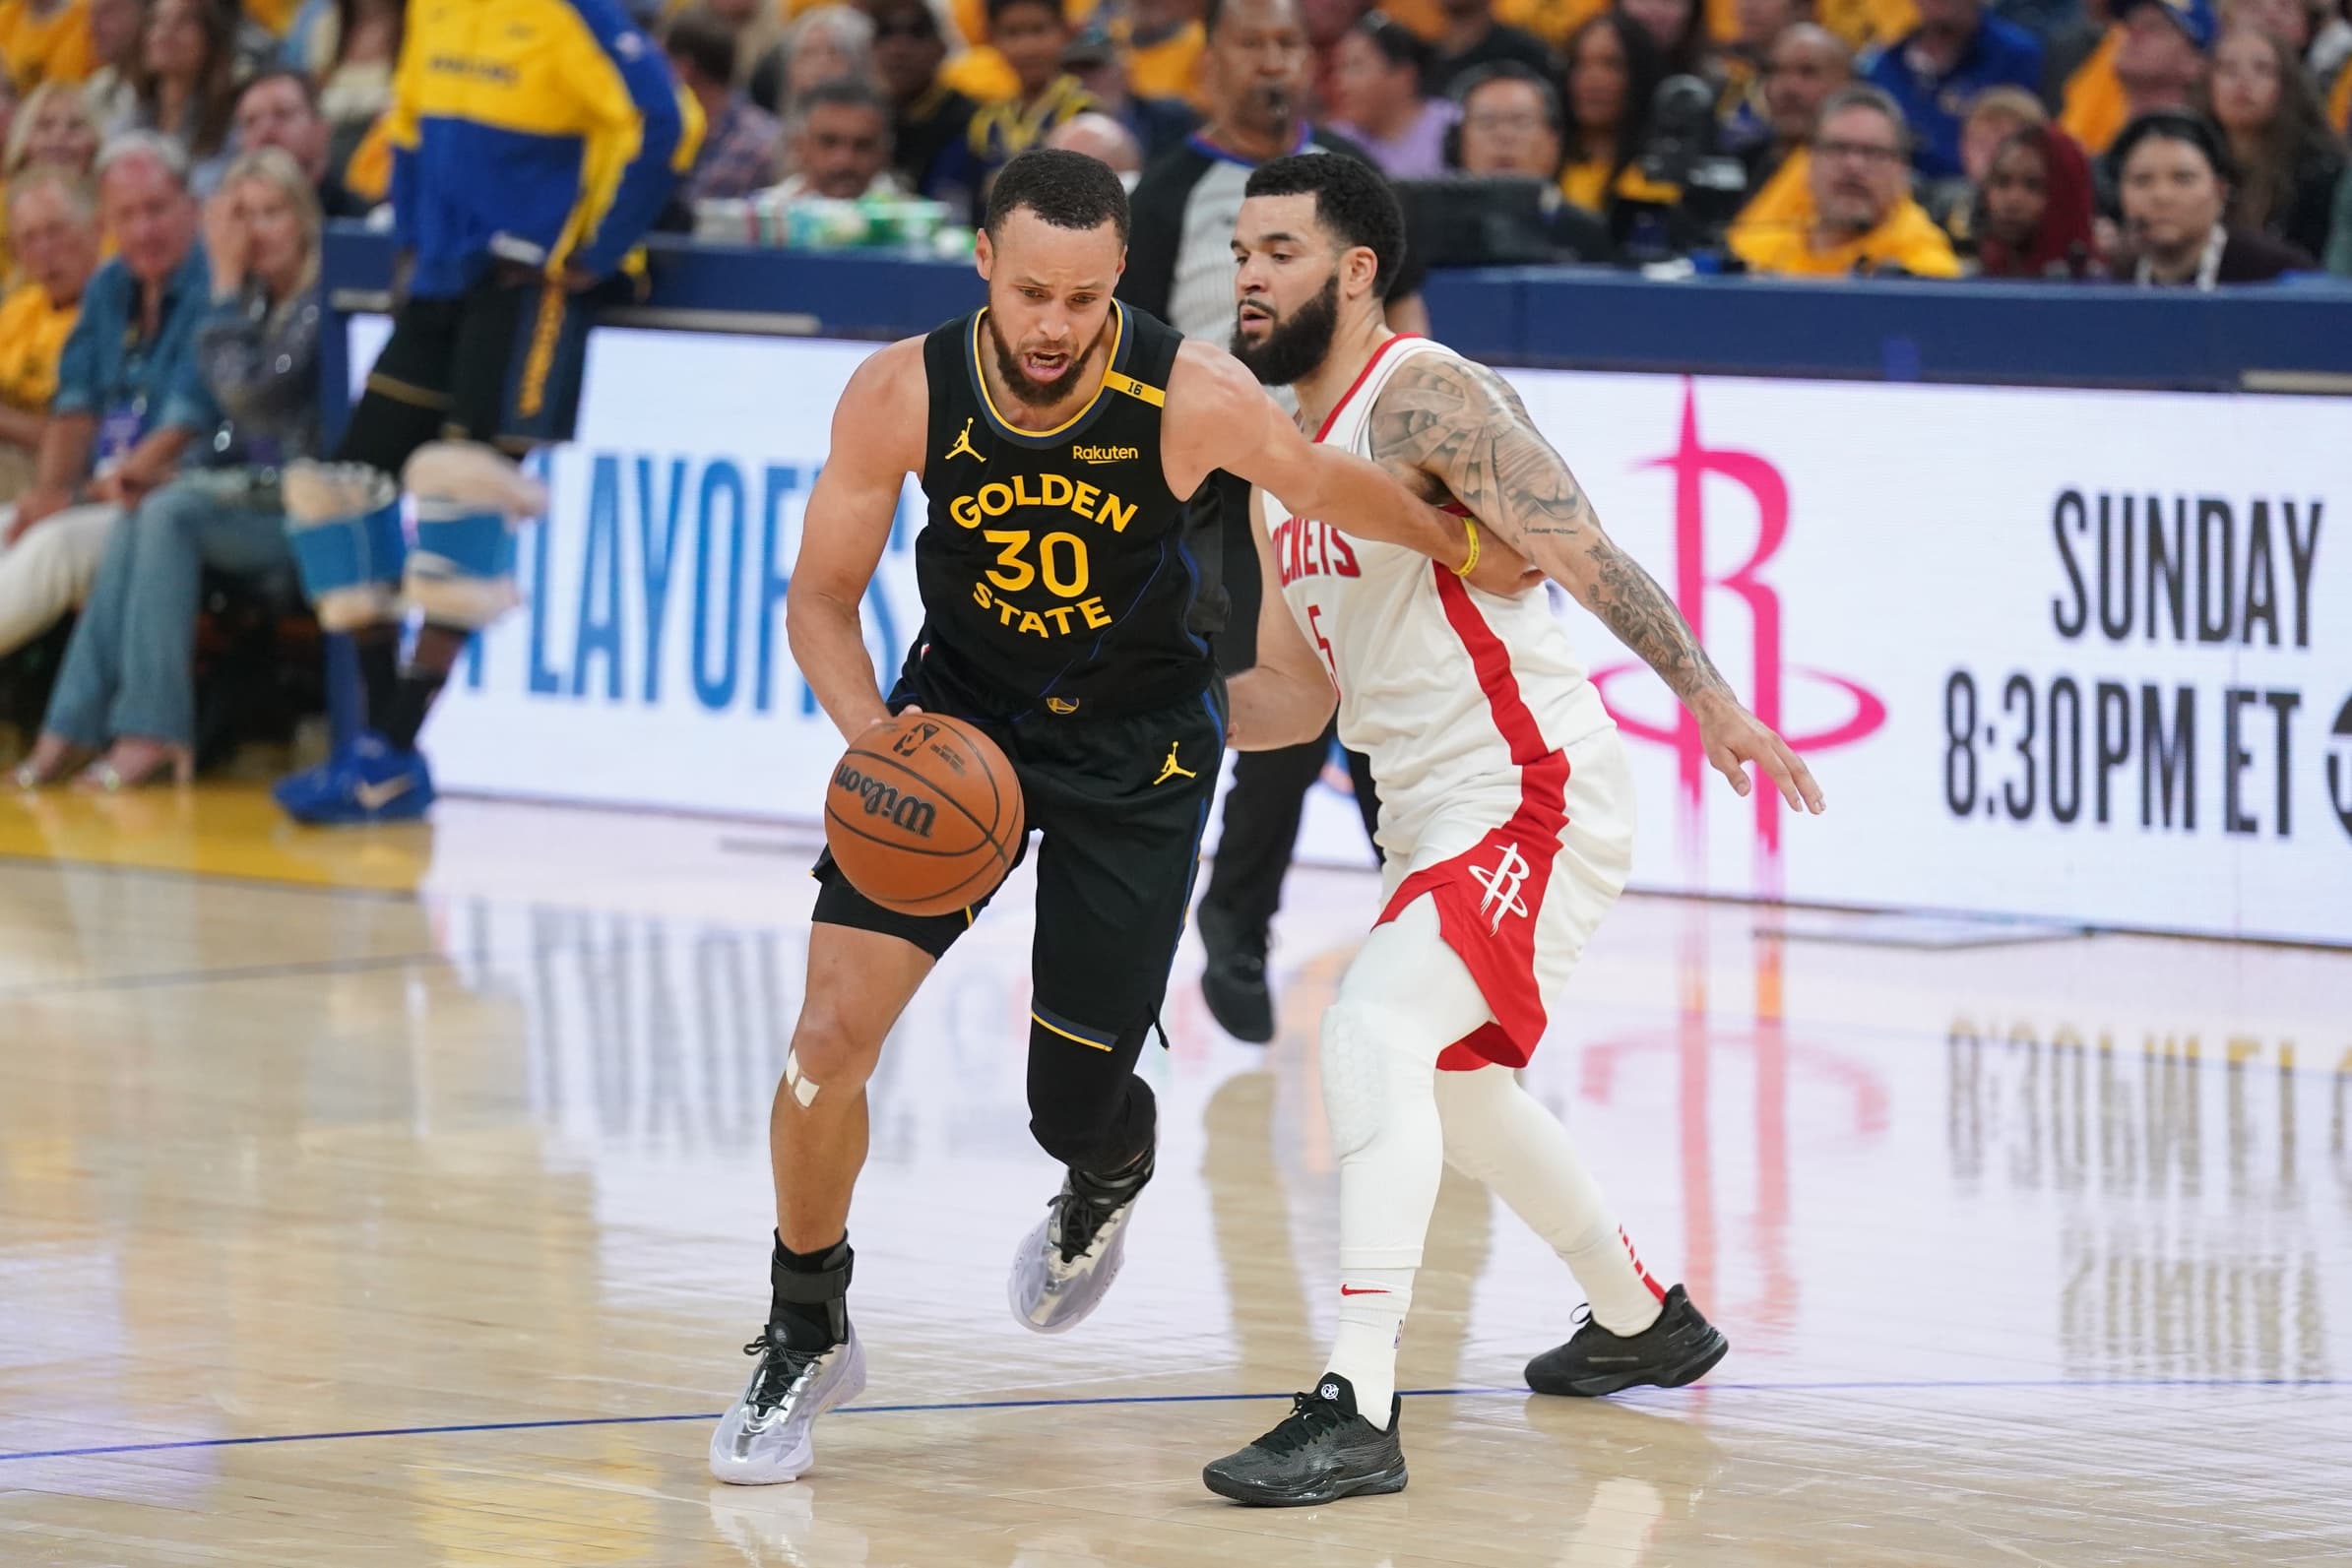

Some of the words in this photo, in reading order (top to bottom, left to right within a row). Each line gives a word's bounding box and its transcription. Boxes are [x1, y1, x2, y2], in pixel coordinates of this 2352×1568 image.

[1127, 381, 1143, 396] 16
[1072, 445, 1138, 463] Rakuten
[950, 473, 1138, 533] GOLDEN
[983, 530, 1089, 597] 30
[2051, 489, 2323, 648] SUNDAY
[973, 582, 1112, 638] STATE
[1945, 670, 2196, 830] 8:30PM
[2225, 688, 2302, 837] ET
[835, 763, 936, 838] Wilson
